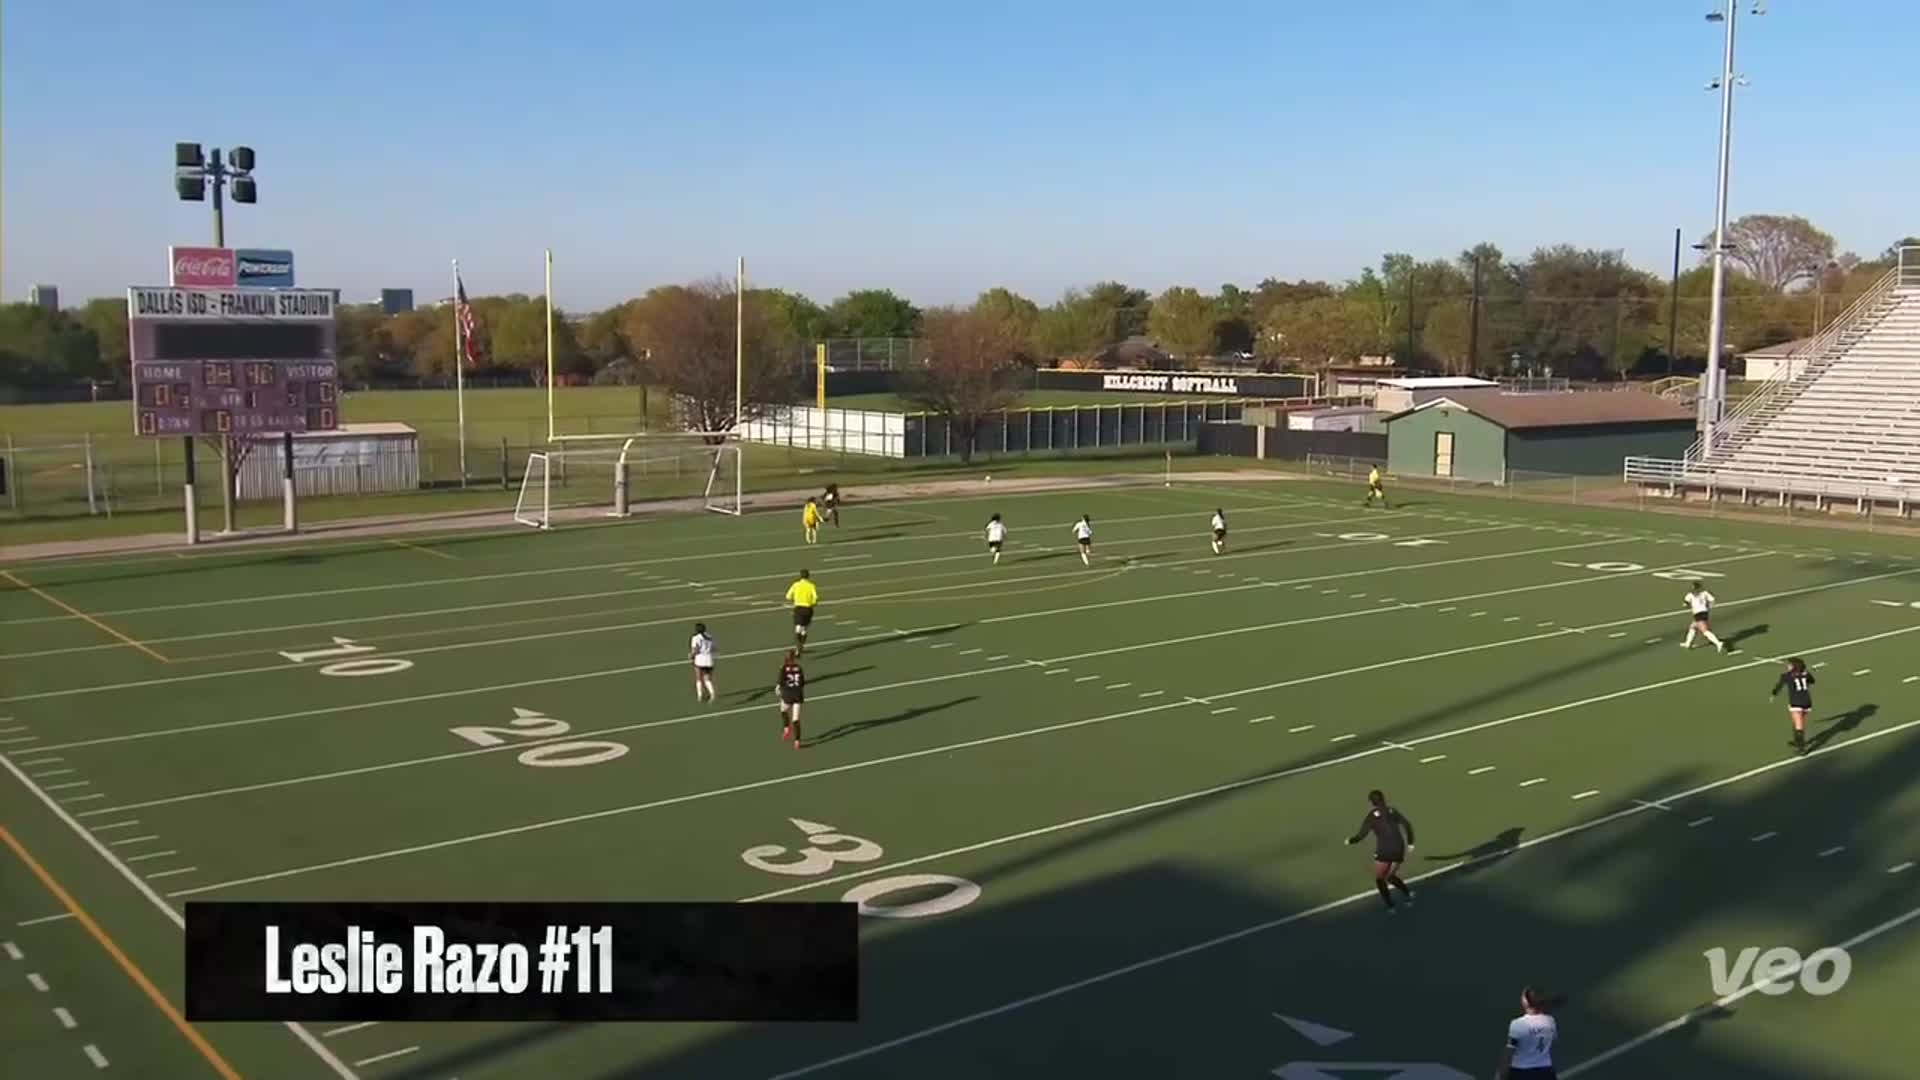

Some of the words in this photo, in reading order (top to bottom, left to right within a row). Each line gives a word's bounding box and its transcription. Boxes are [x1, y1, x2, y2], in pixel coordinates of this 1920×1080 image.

[175, 256, 231, 277] Coca-Cola
[138, 292, 183, 314] DALLAS
[187, 292, 206, 314] ISD
[221, 293, 276, 315] FRANKLIN
[279, 294, 329, 316] STADIUM
[143, 367, 182, 379] HOME
[286, 366, 334, 377] VISITOR
[1103, 375, 1169, 391] HILLCREST
[1172, 376, 1238, 393] SOFTBALL
[1794, 677, 1808, 691] 11
